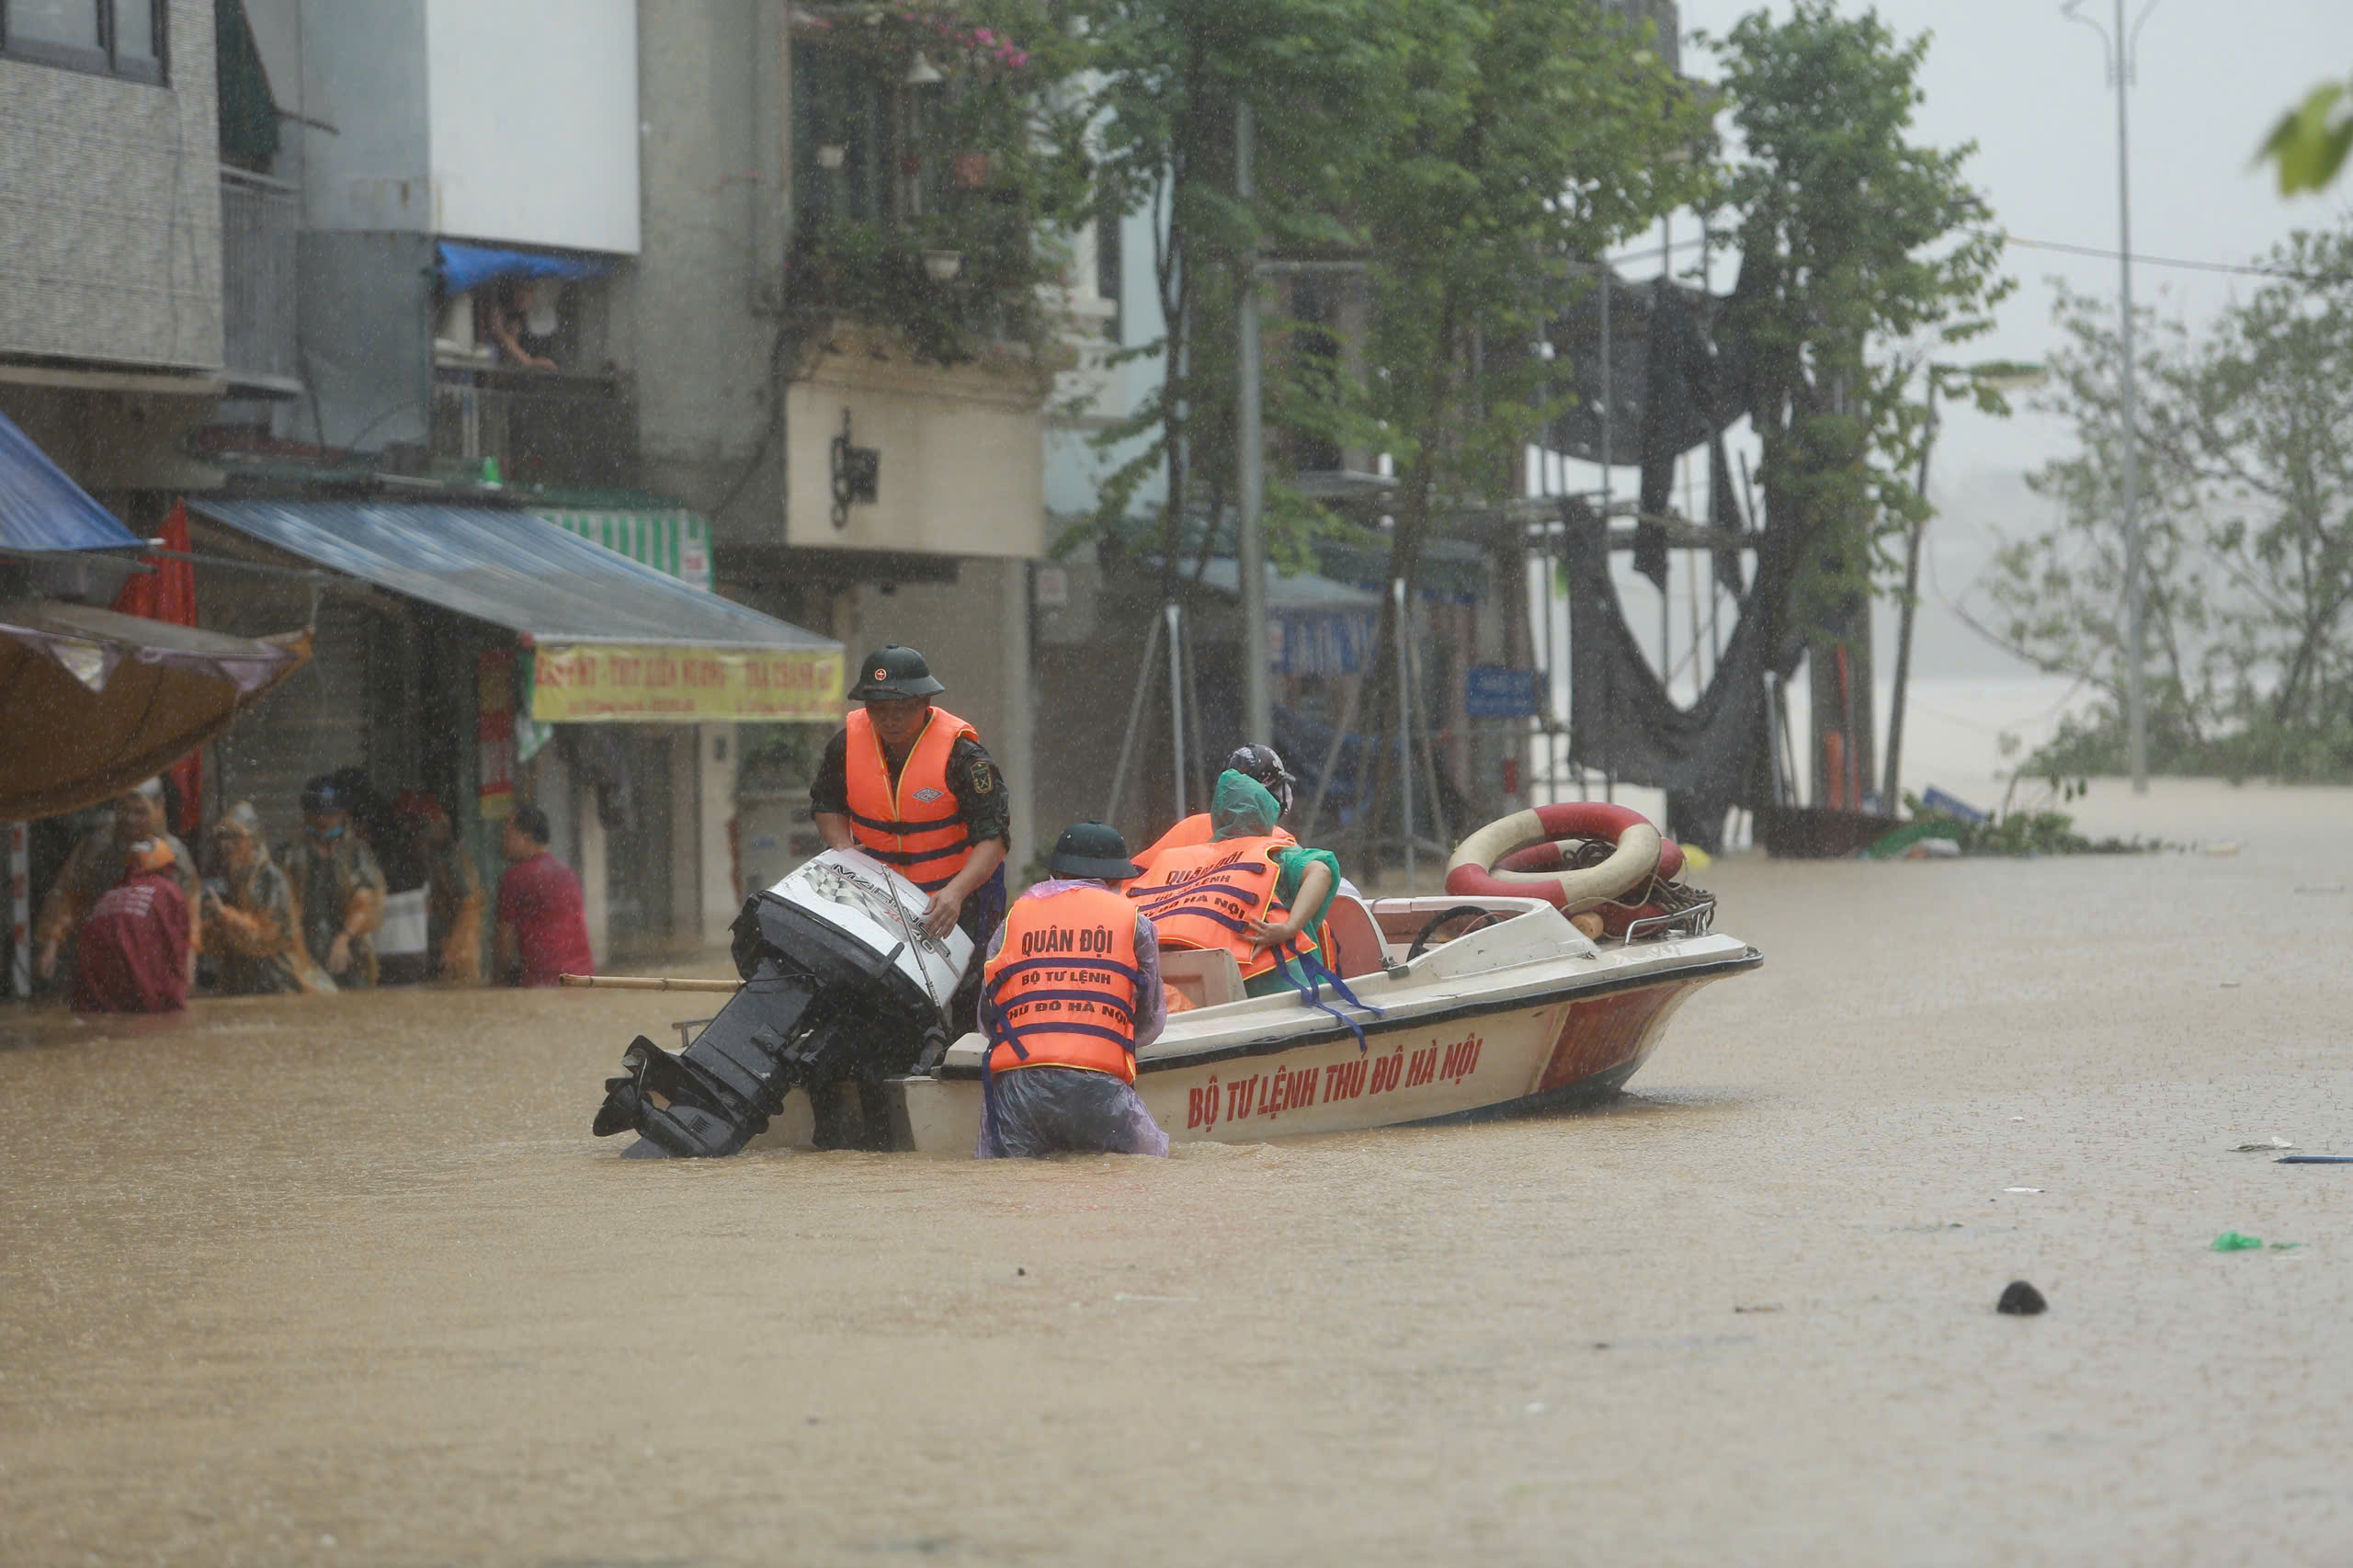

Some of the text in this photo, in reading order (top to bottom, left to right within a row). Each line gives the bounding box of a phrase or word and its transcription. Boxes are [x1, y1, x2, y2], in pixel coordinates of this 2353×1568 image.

[1214, 897, 1245, 919] NỘI
[911, 928, 935, 954] 40
[1021, 925, 1113, 958] QUÂN ĐỘI
[1021, 970, 1111, 986] BỘ TƯ LỆNH
[1035, 1000, 1062, 1012] ĐÔ
[1068, 1000, 1096, 1013] HÀ
[1102, 1006, 1127, 1026] NỘI
[1187, 1031, 1483, 1132] BỘ TƯ LỆNH THỦ ĐÔ HÀ NỘI
